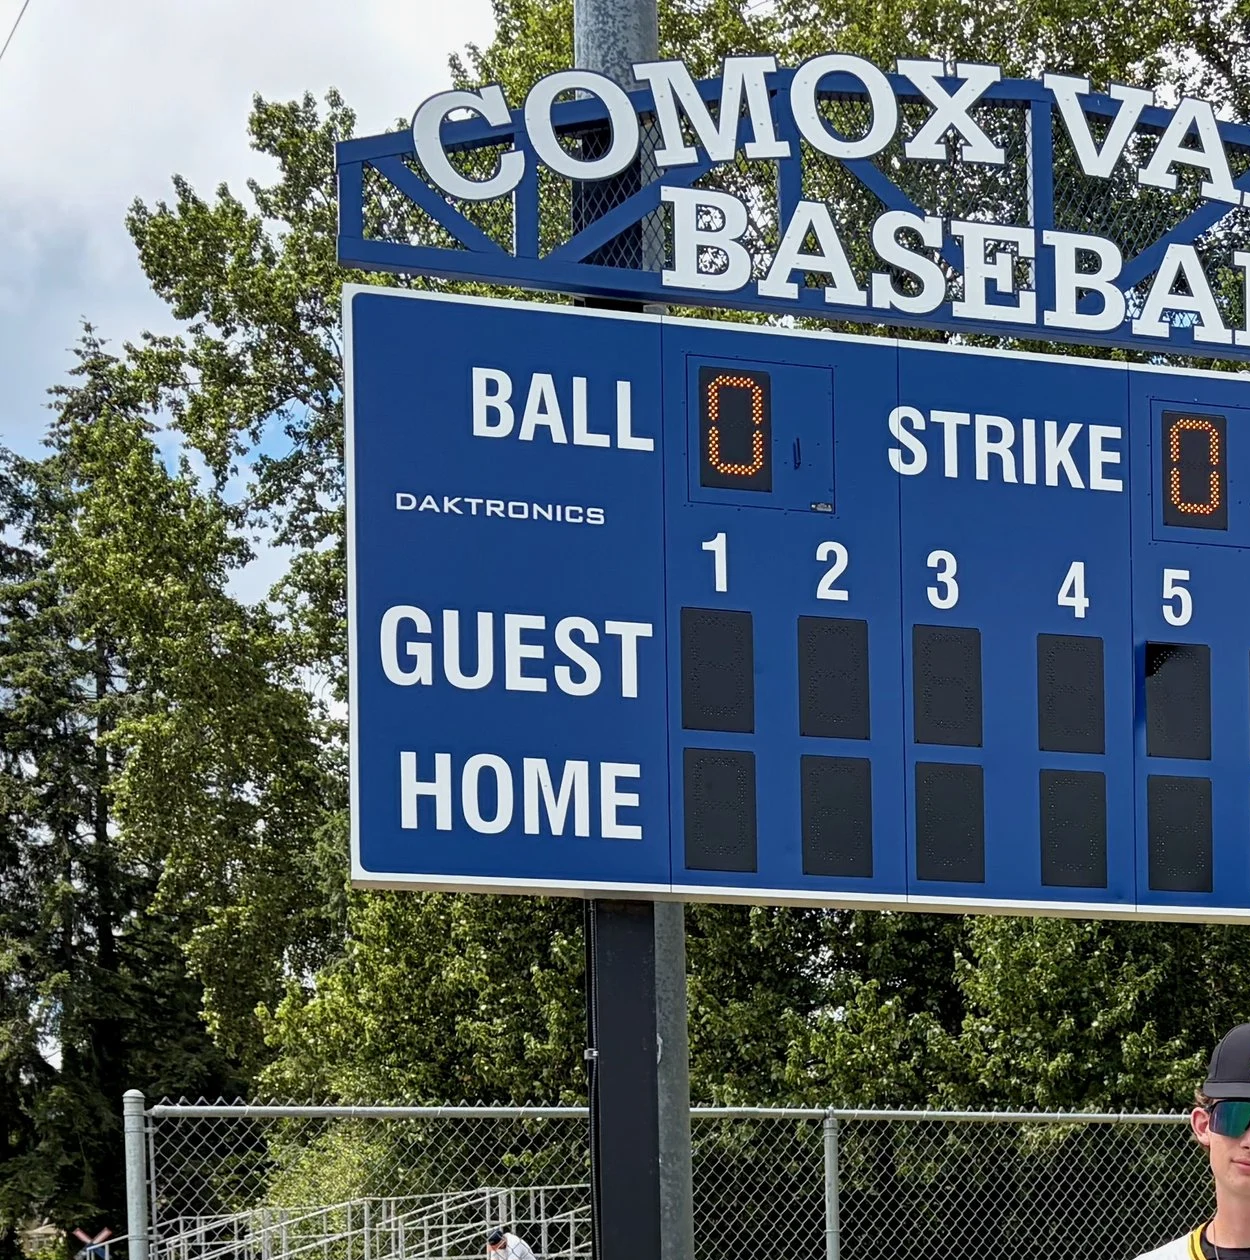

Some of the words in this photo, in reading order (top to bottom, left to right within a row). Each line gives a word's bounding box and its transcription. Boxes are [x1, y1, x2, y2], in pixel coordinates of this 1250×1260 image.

[411, 53, 1005, 200] COMOX
[472, 367, 654, 452] BALL
[707, 375, 763, 476] 0
[888, 406, 1123, 492] STRIKE
[395, 492, 606, 526] DAKTRONICS
[1169, 417, 1221, 516] 0
[702, 532, 728, 592] 1
[816, 541, 850, 601] 2
[926, 550, 959, 609] 3
[1057, 561, 1090, 618] 4
[1162, 568, 1193, 627] 5
[379, 604, 653, 698] GUEST
[400, 751, 642, 840] HOME
